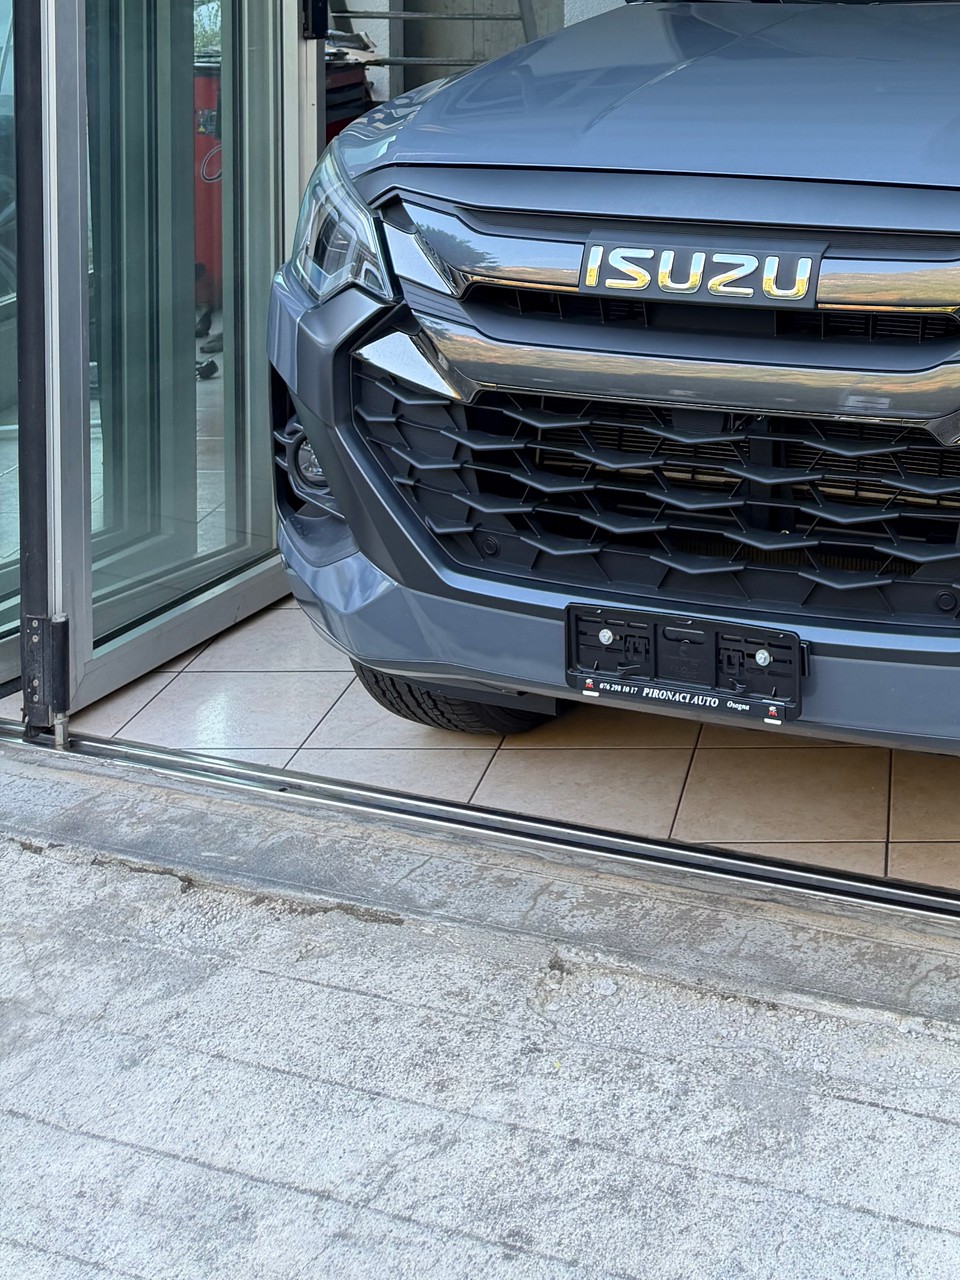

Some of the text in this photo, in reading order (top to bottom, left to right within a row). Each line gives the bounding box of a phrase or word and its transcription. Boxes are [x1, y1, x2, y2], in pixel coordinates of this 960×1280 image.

[585, 245, 813, 300] ISUZU
[599, 682, 750, 711] 076 298 10 17 PIRONACI AUTO Osogna
